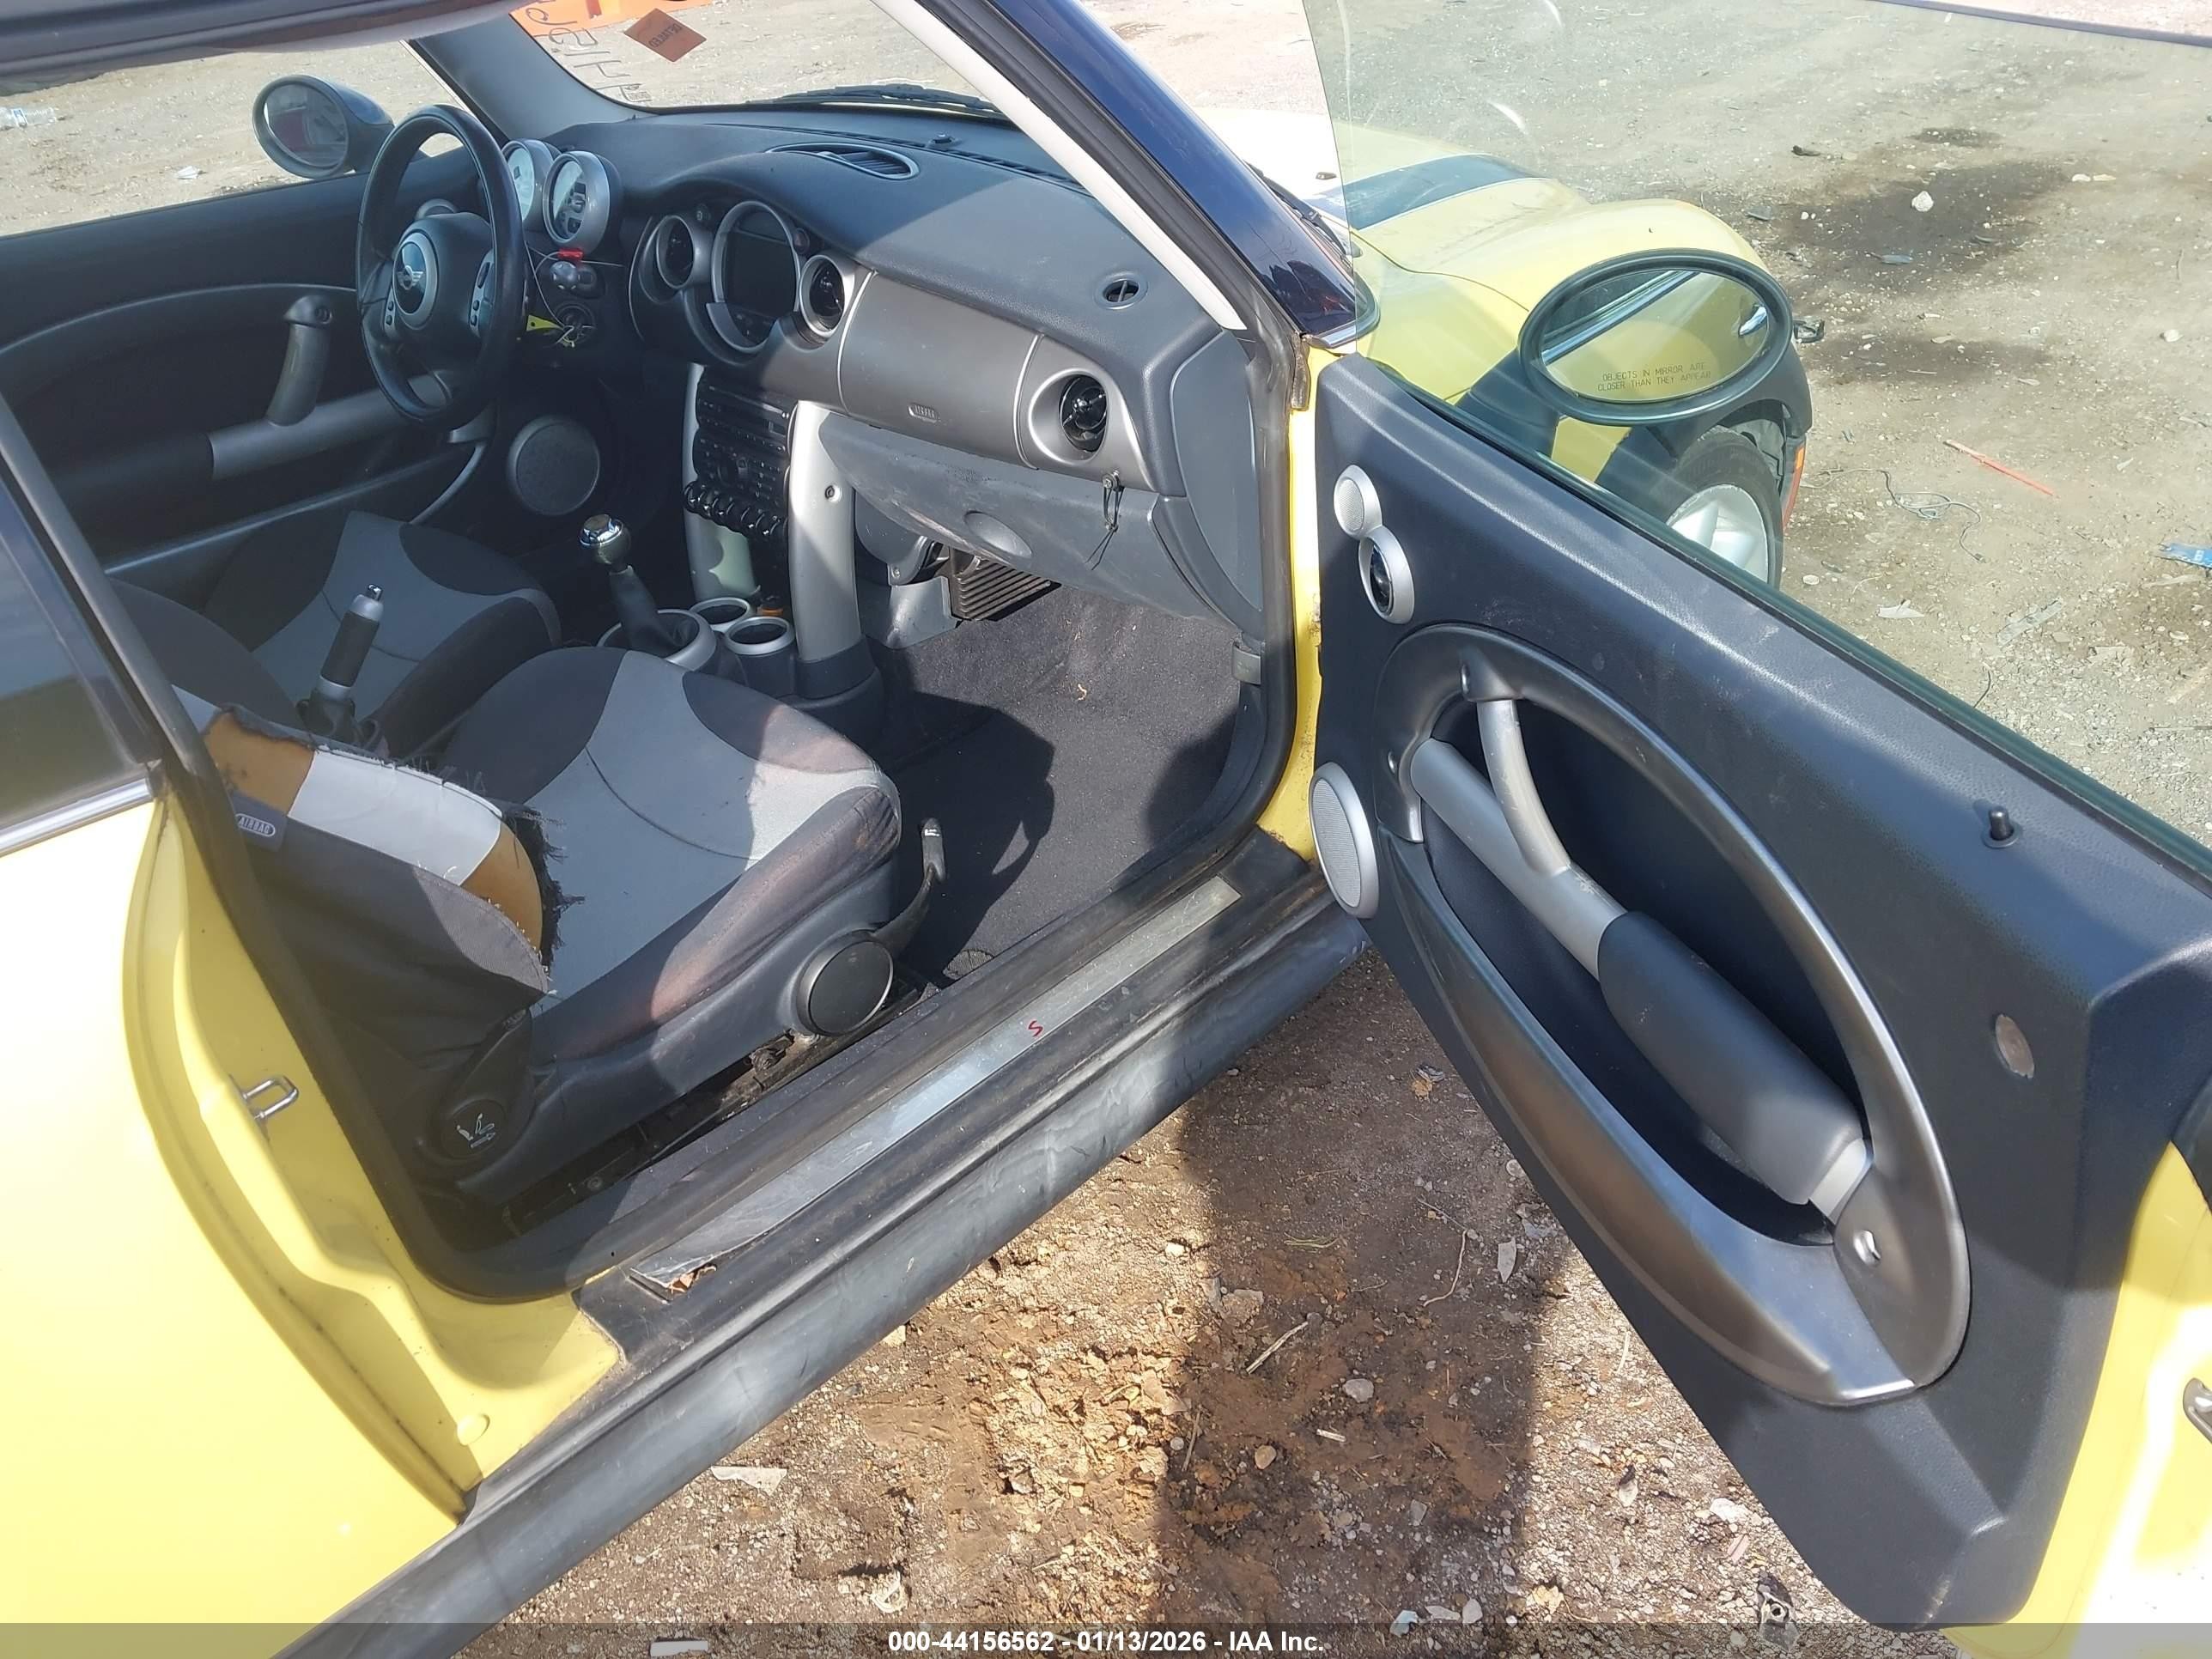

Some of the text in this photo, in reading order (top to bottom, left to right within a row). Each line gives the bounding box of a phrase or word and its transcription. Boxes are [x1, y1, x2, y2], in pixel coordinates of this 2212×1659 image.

[1597, 370, 1711, 392] CLOSER THAN THEY APPEAR
[1602, 370, 1638, 382] OBJECTS
[1655, 364, 1684, 376] MIRROR
[1689, 362, 1705, 371] ARE
[238, 816, 270, 835] AIRBAG
